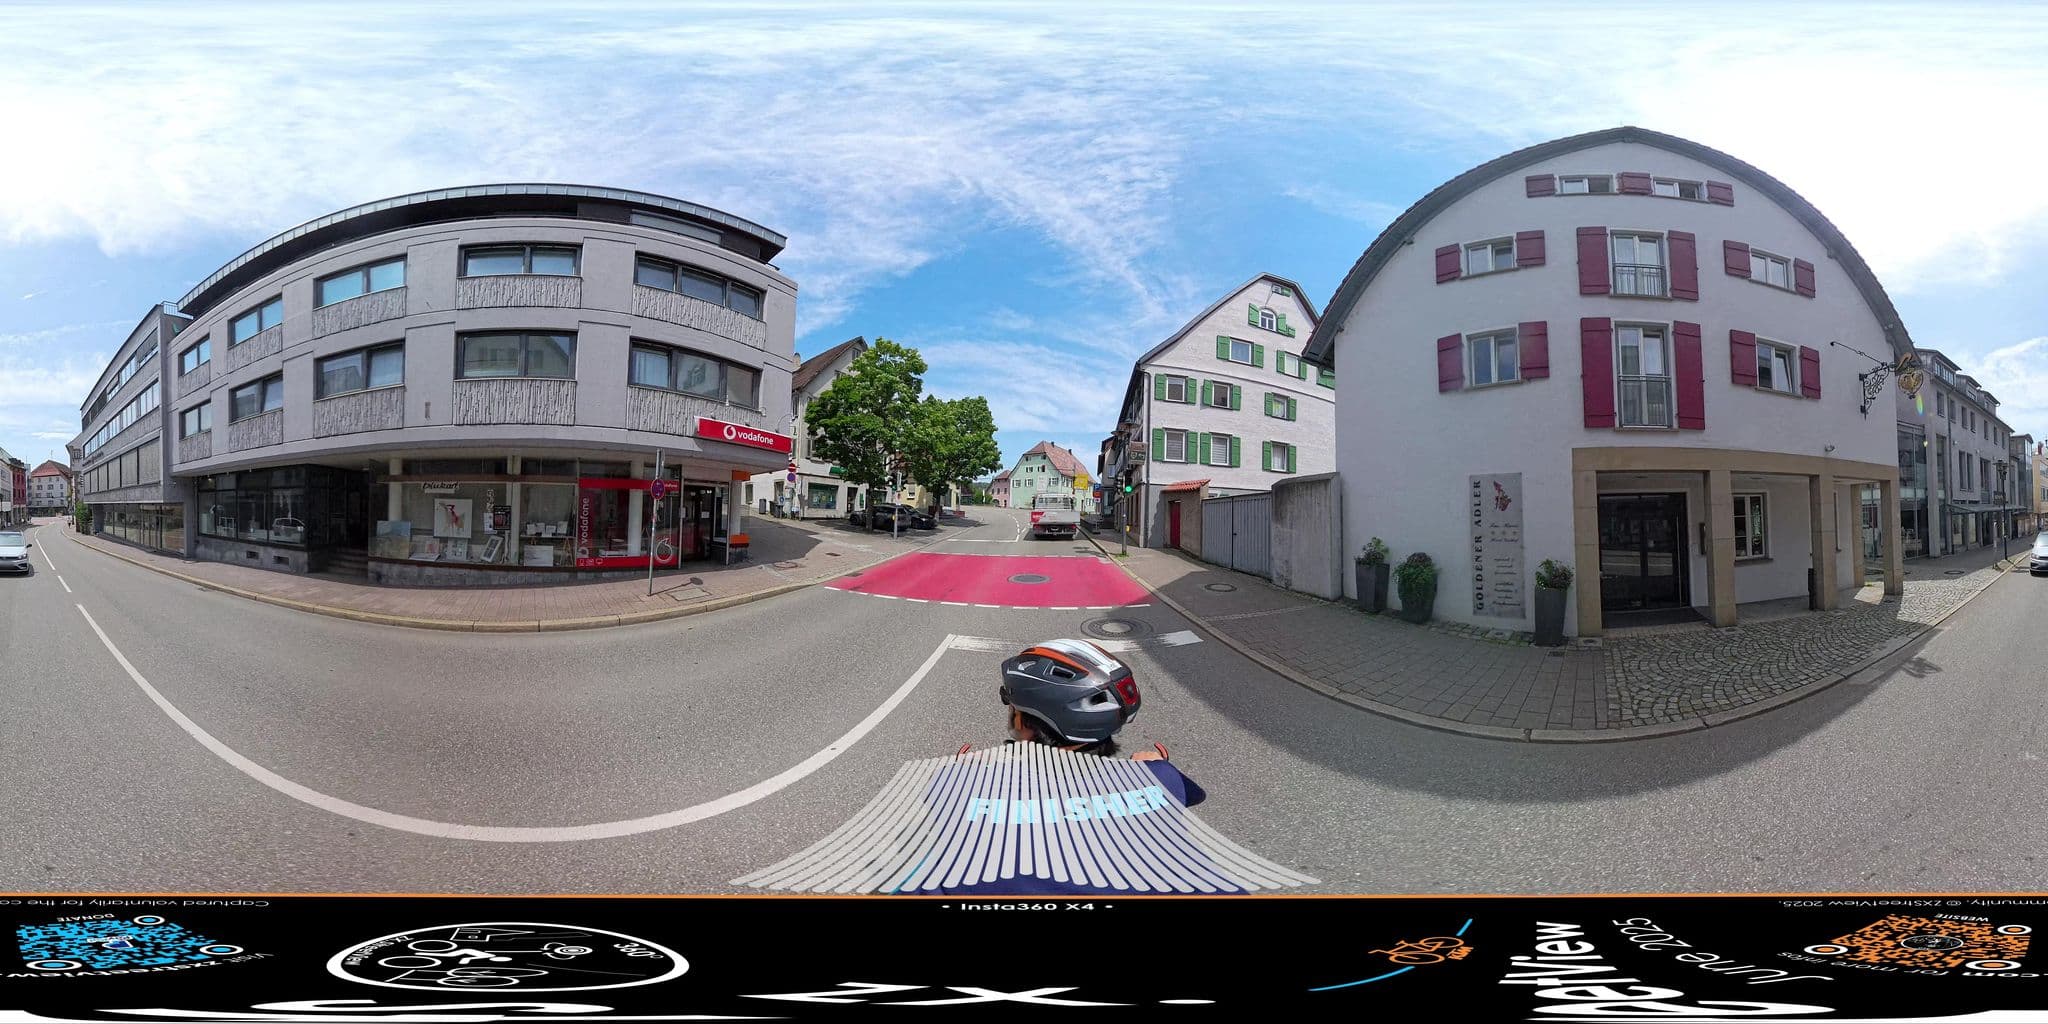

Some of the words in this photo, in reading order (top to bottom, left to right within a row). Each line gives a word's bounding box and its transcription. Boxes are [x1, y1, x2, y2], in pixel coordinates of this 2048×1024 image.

[737, 430, 775, 445] vodafone
[580, 497, 590, 544] vodafone
[1473, 480, 1482, 527] ADLER
[1474, 535, 1484, 610] GOLDENER
[966, 785, 1170, 825] FINISHER
